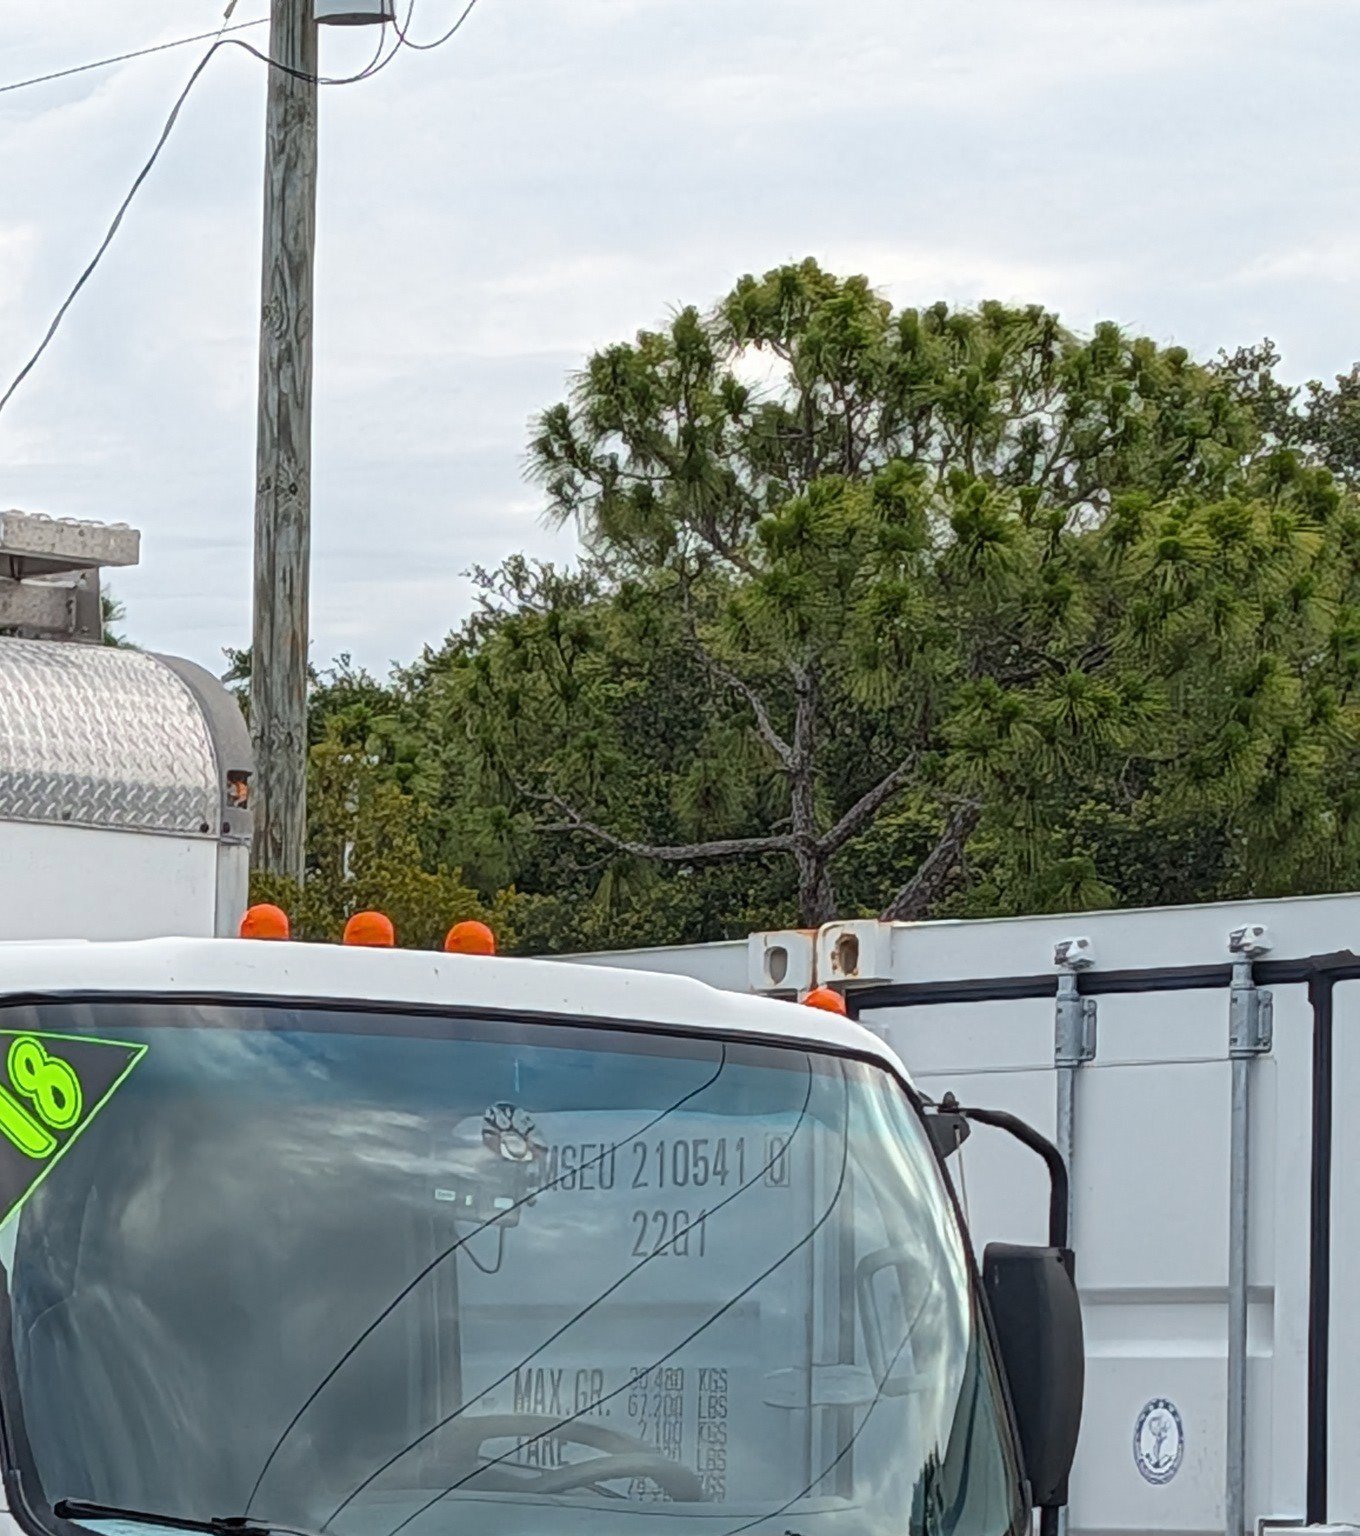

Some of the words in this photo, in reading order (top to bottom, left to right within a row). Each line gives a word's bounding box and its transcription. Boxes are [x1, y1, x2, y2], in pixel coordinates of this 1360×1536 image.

[631, 1136, 745, 1189] 210541
[632, 1209, 707, 1258] 22G1
[698, 1368, 728, 1393] KGS
[698, 1394, 728, 1419] LBS
